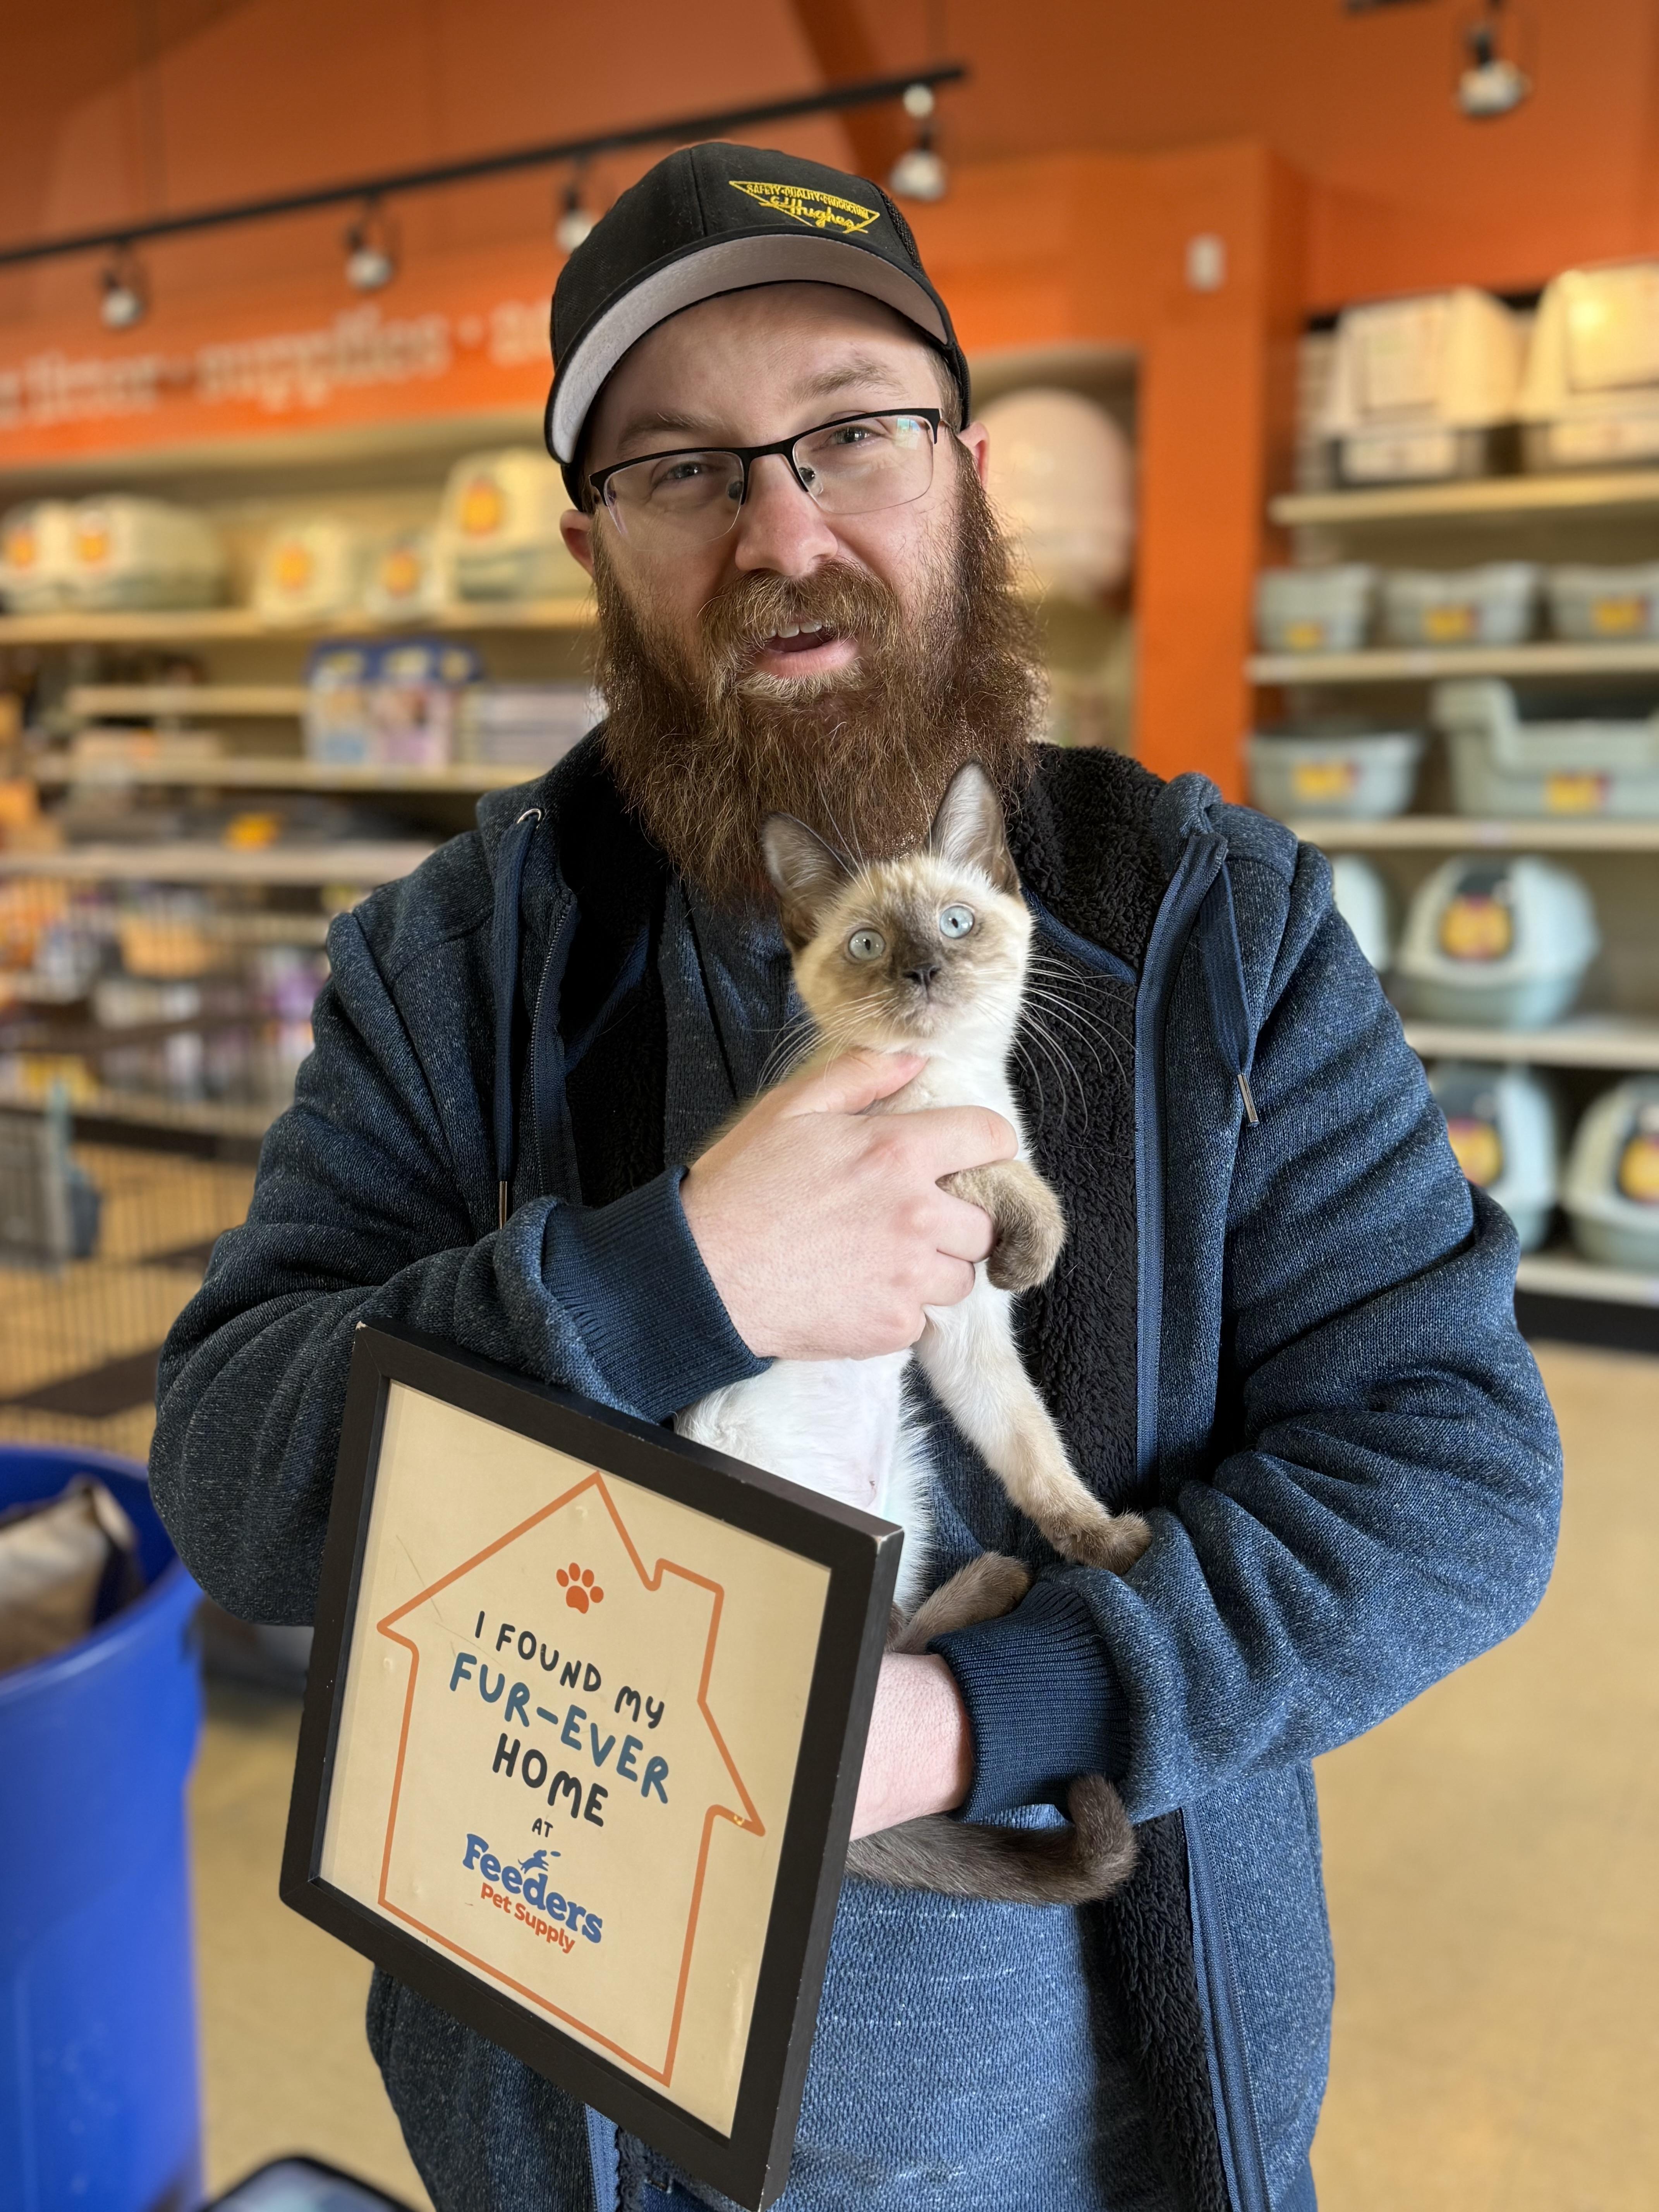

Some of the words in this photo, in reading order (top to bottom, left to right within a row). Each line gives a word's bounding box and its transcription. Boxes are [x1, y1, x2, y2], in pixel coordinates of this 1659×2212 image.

[475, 1610, 485, 1639] I
[496, 1623, 602, 1692] FOUND
[449, 1652, 669, 1804] FUR-EVER
[492, 1733, 609, 1827] HOME
[531, 1817, 554, 1838] AT
[462, 1833, 603, 1944] Feeders
[481, 1882, 512, 1914] Pet
[514, 1902, 575, 1954] Supply
